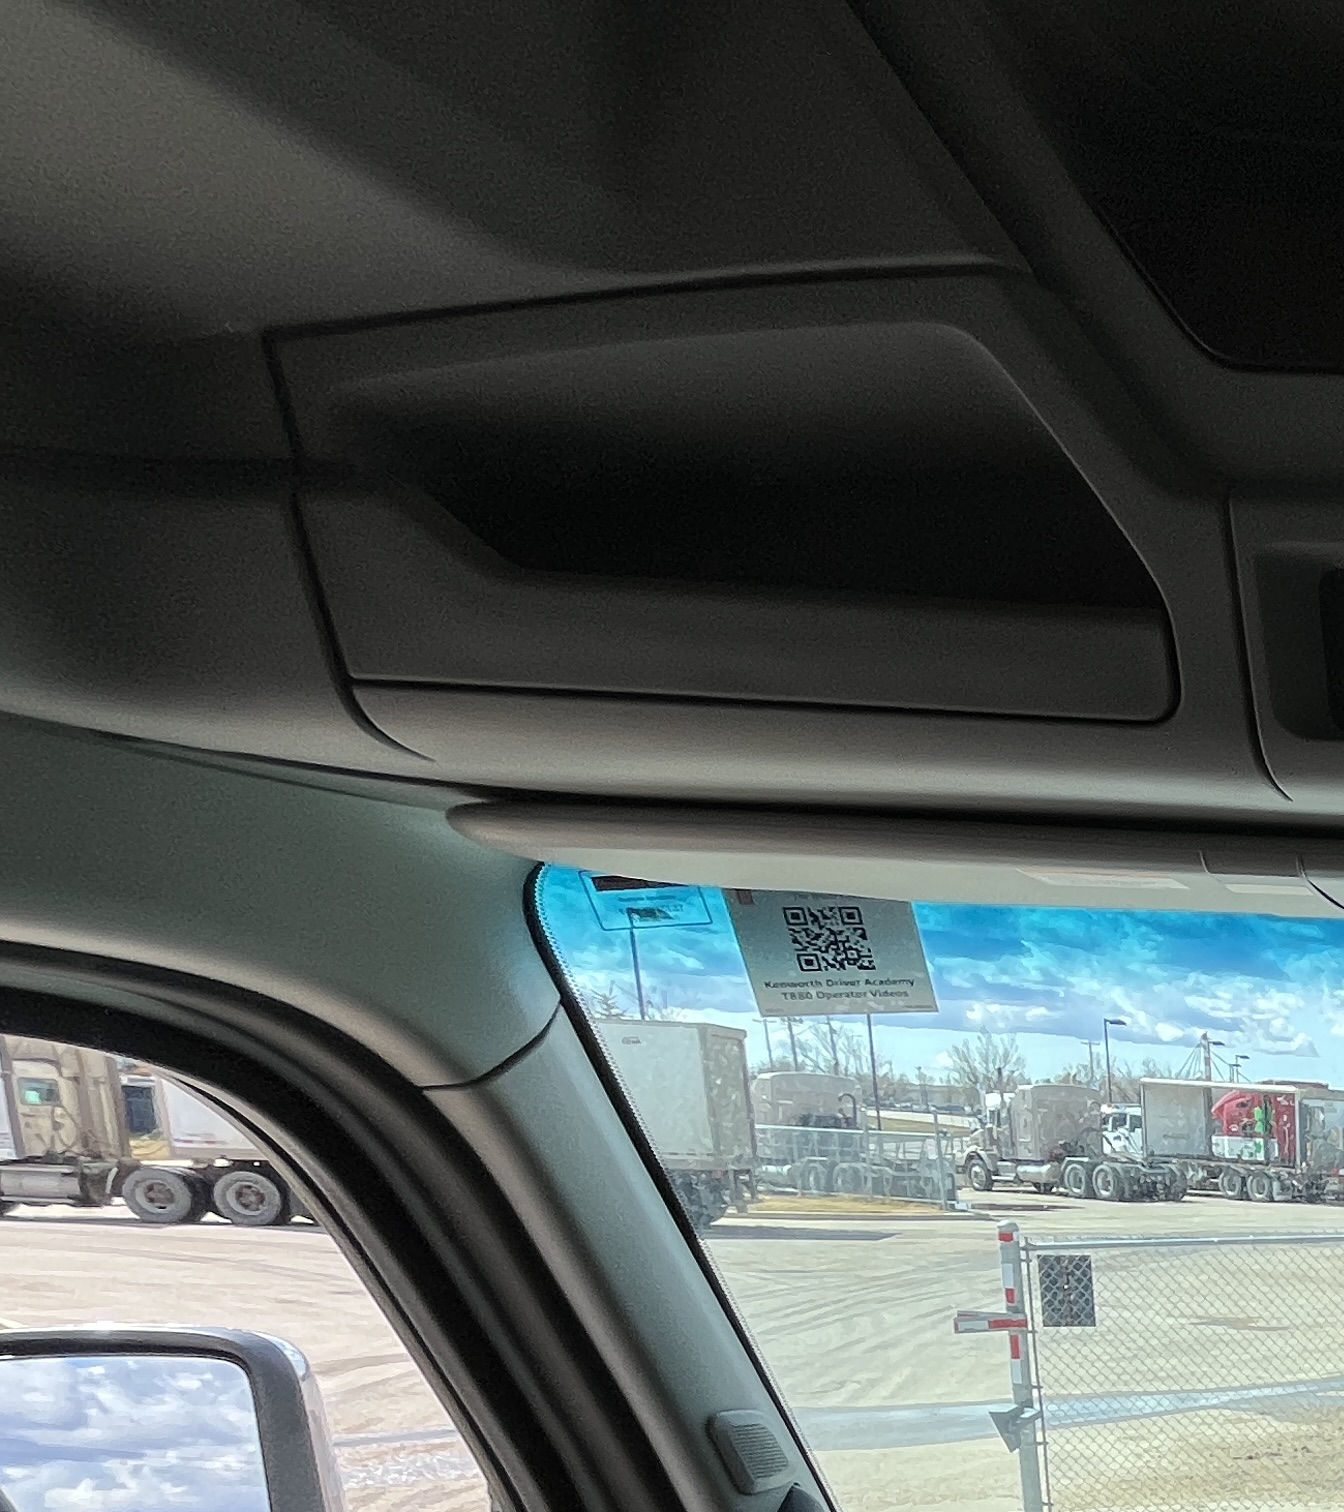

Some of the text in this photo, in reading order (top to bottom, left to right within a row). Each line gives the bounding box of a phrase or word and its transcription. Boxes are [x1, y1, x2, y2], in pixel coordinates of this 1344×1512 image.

[764, 977, 915, 989] Kenworth Driver Academy
[816, 989, 868, 1001] Operator
[870, 989, 909, 999] Videos
